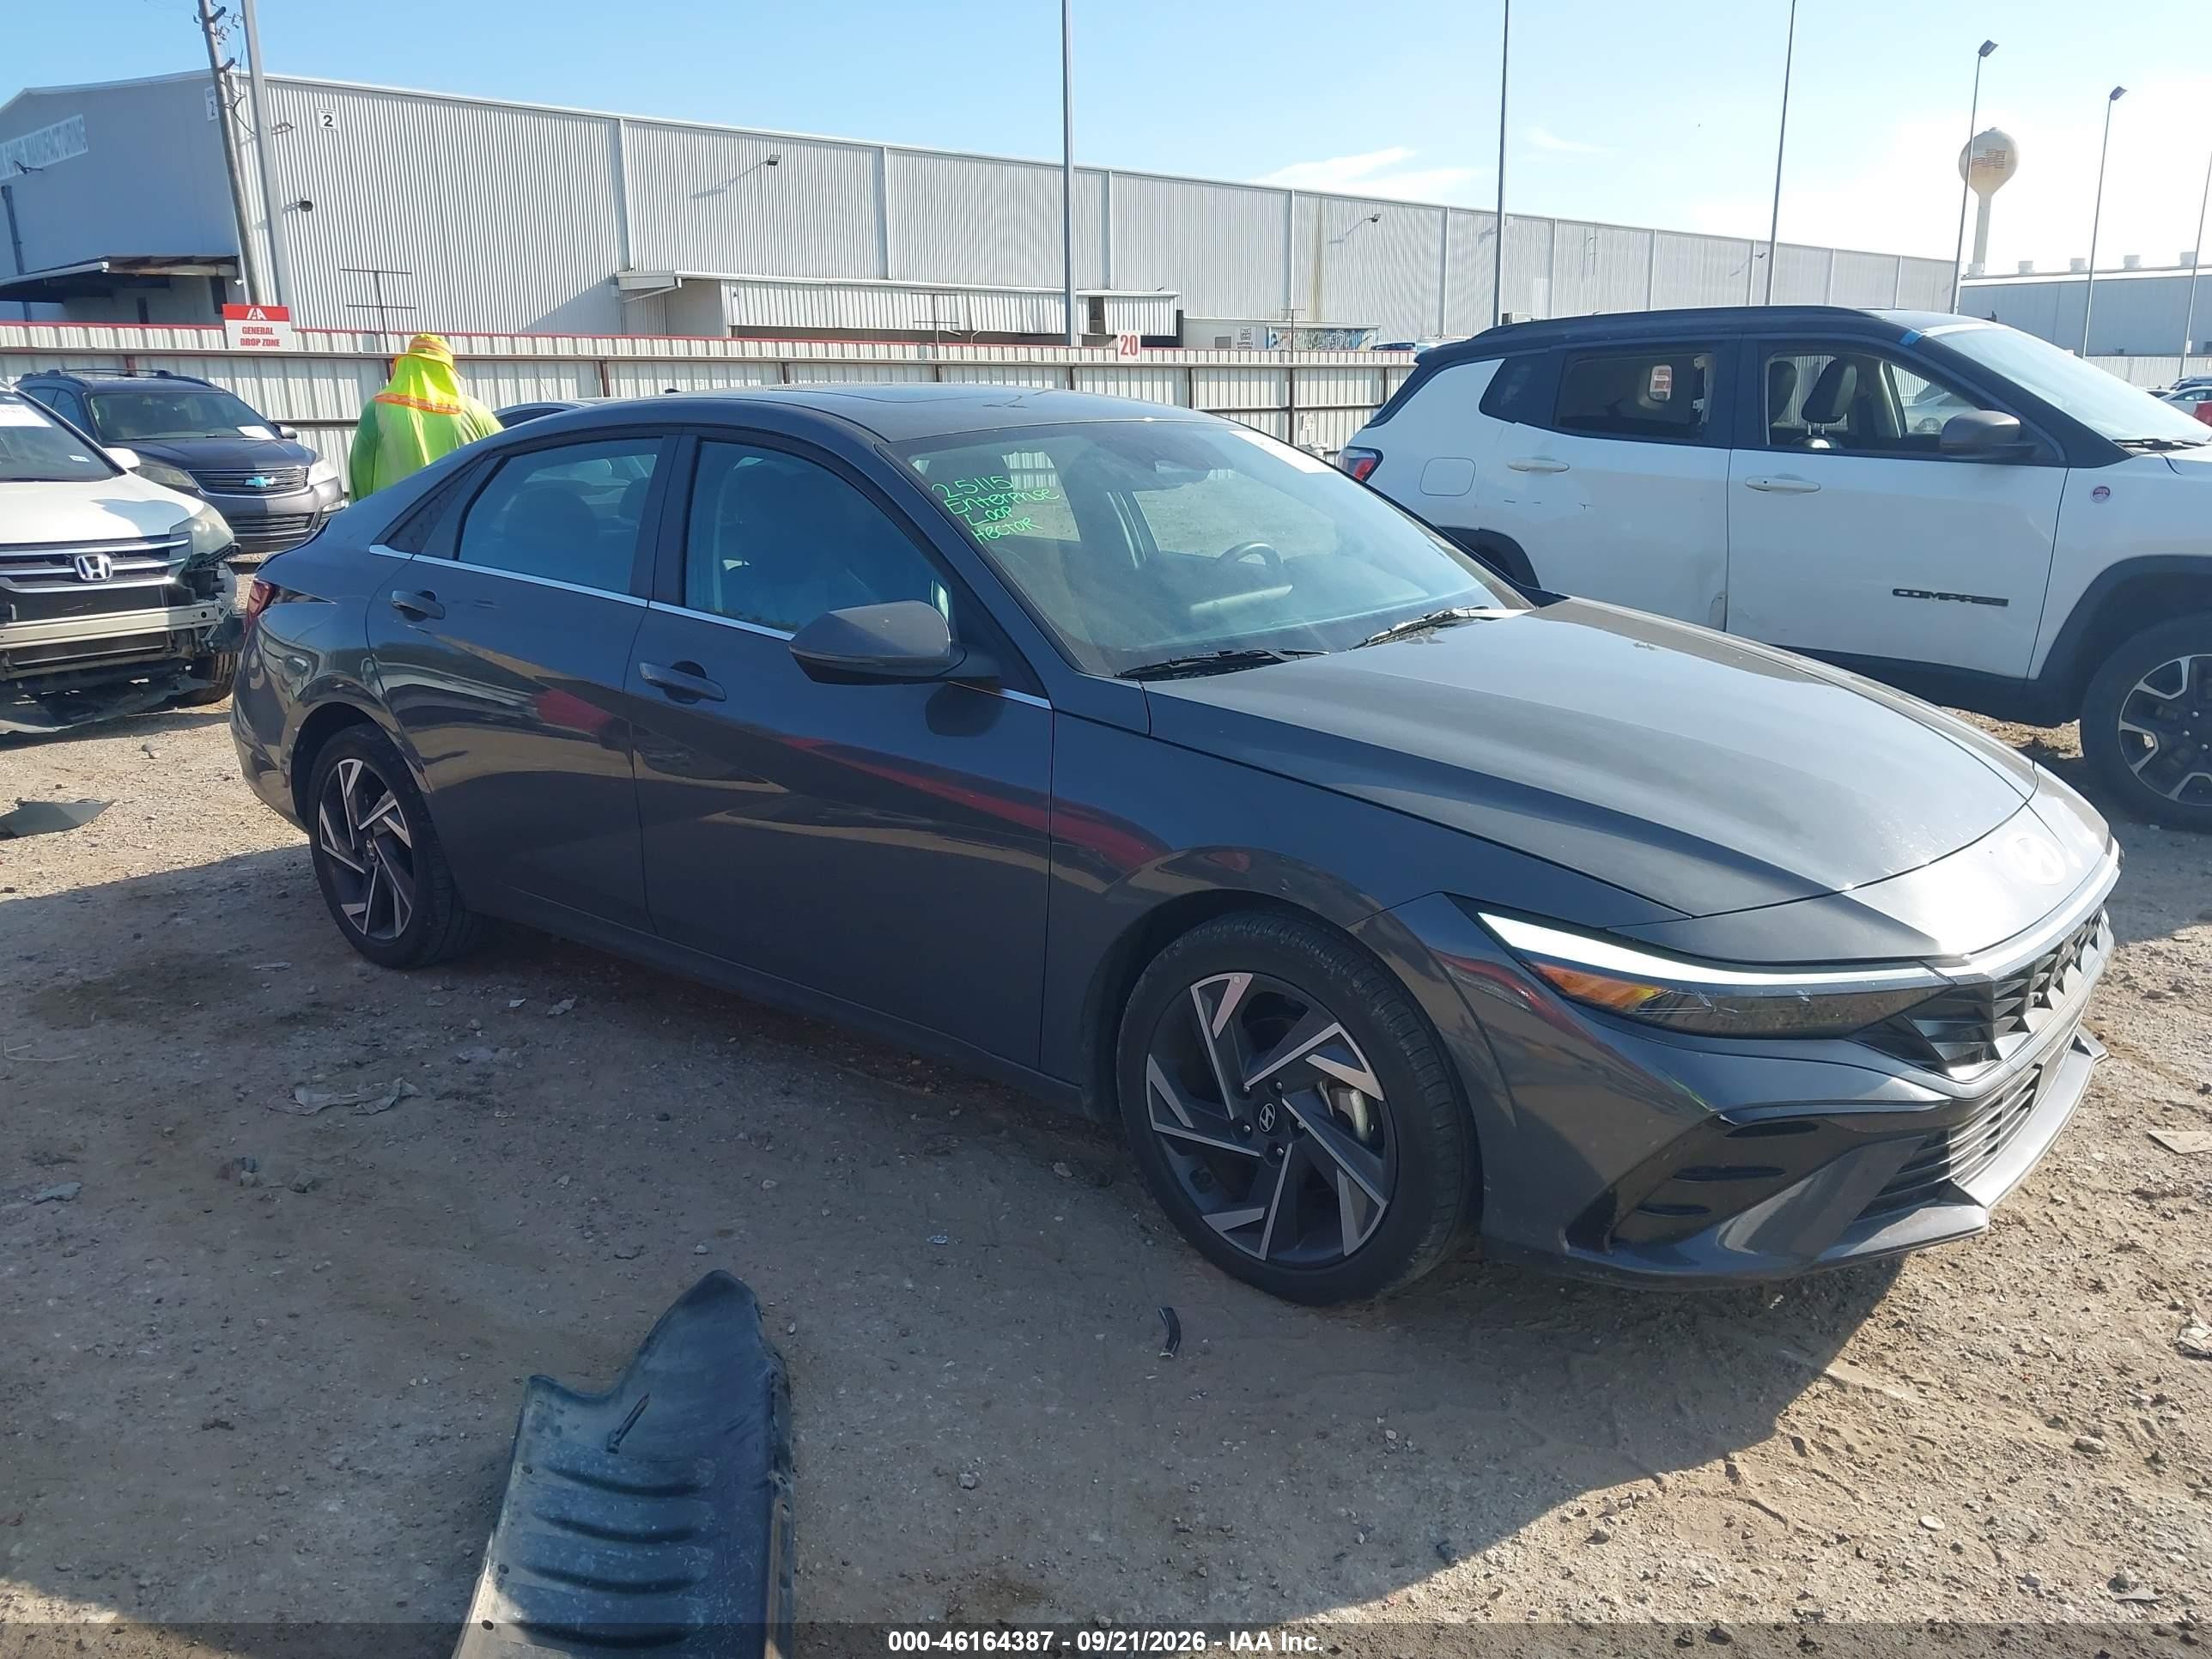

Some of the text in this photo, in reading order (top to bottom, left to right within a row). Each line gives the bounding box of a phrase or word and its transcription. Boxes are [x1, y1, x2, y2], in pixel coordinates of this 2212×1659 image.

[323, 114, 333, 127] 2
[241, 326, 274, 335] GENERAL
[240, 337, 281, 348] DROP ZONE
[1120, 334, 1139, 356] 20
[932, 475, 1014, 498] 25115
